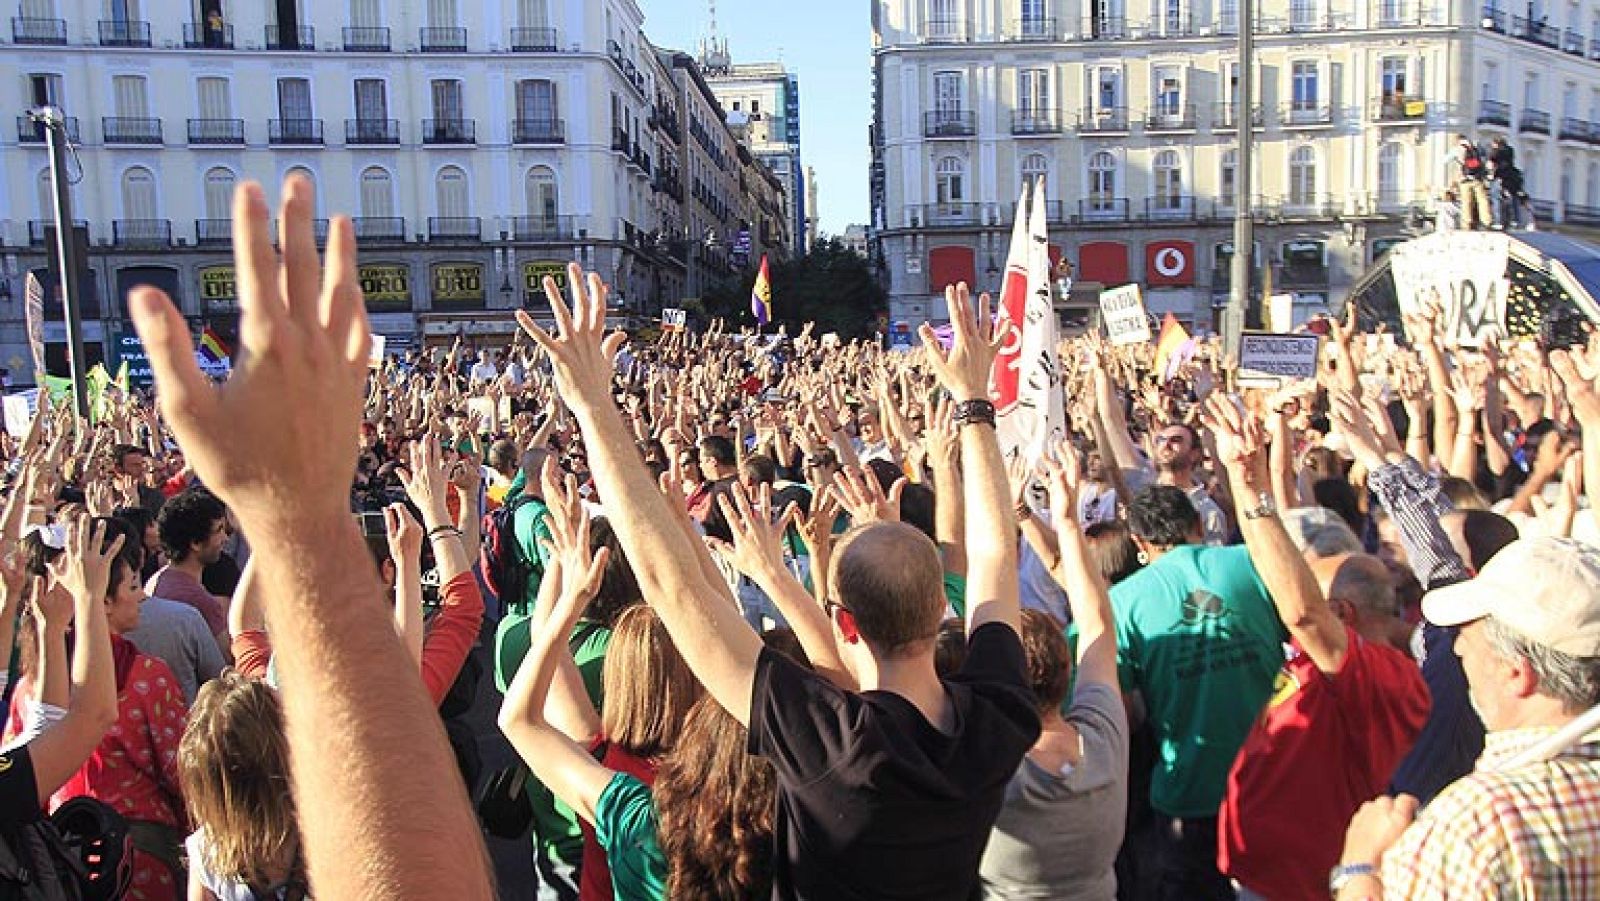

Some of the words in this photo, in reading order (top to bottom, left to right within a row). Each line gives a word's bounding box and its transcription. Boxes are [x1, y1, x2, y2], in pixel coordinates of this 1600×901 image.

[205, 281, 236, 297] OR
[360, 277, 407, 293] ORO
[435, 277, 480, 291] ORO
